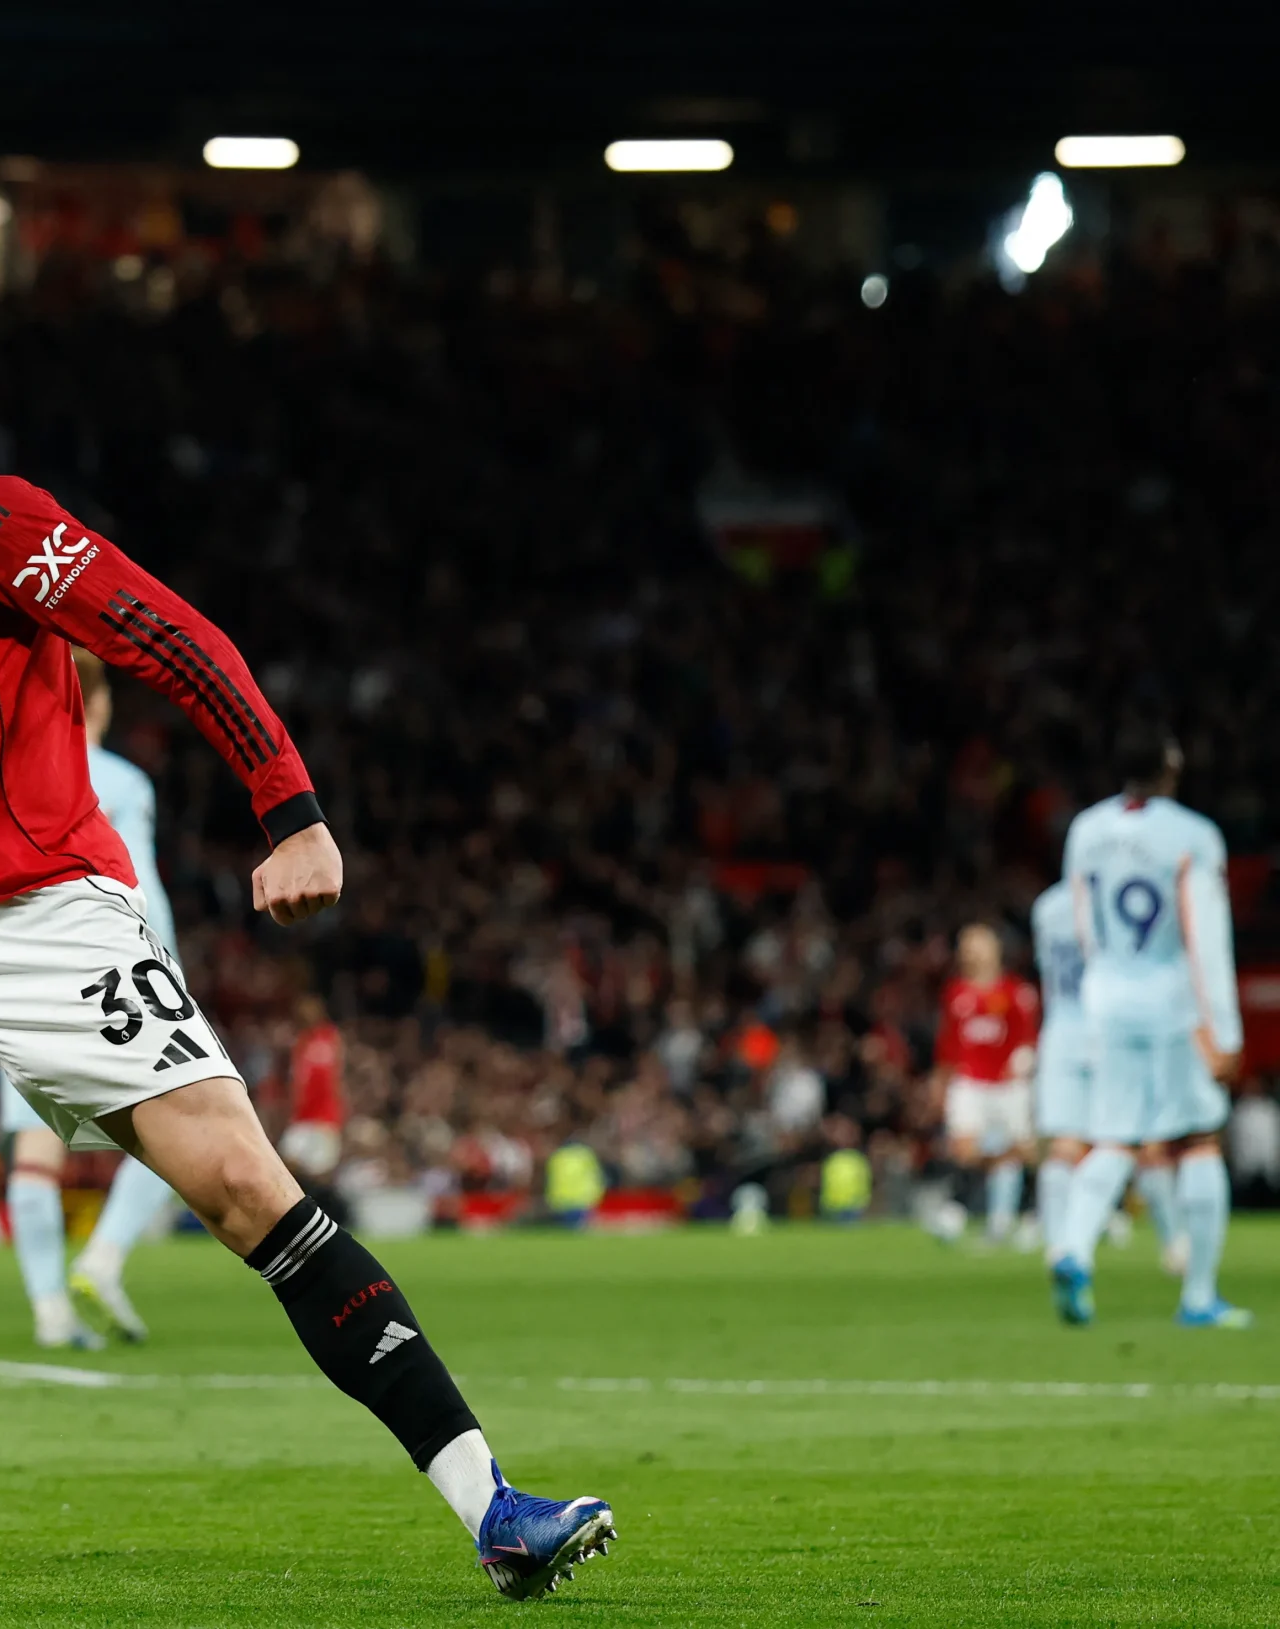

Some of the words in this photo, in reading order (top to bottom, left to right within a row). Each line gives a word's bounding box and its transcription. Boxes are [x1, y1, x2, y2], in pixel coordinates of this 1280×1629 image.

[12, 522, 90, 603] DXC
[45, 544, 100, 610] TECHNOLOGY
[1086, 871, 1163, 952] 19
[80, 958, 195, 1046] 30
[332, 1280, 393, 1328] MUFC
